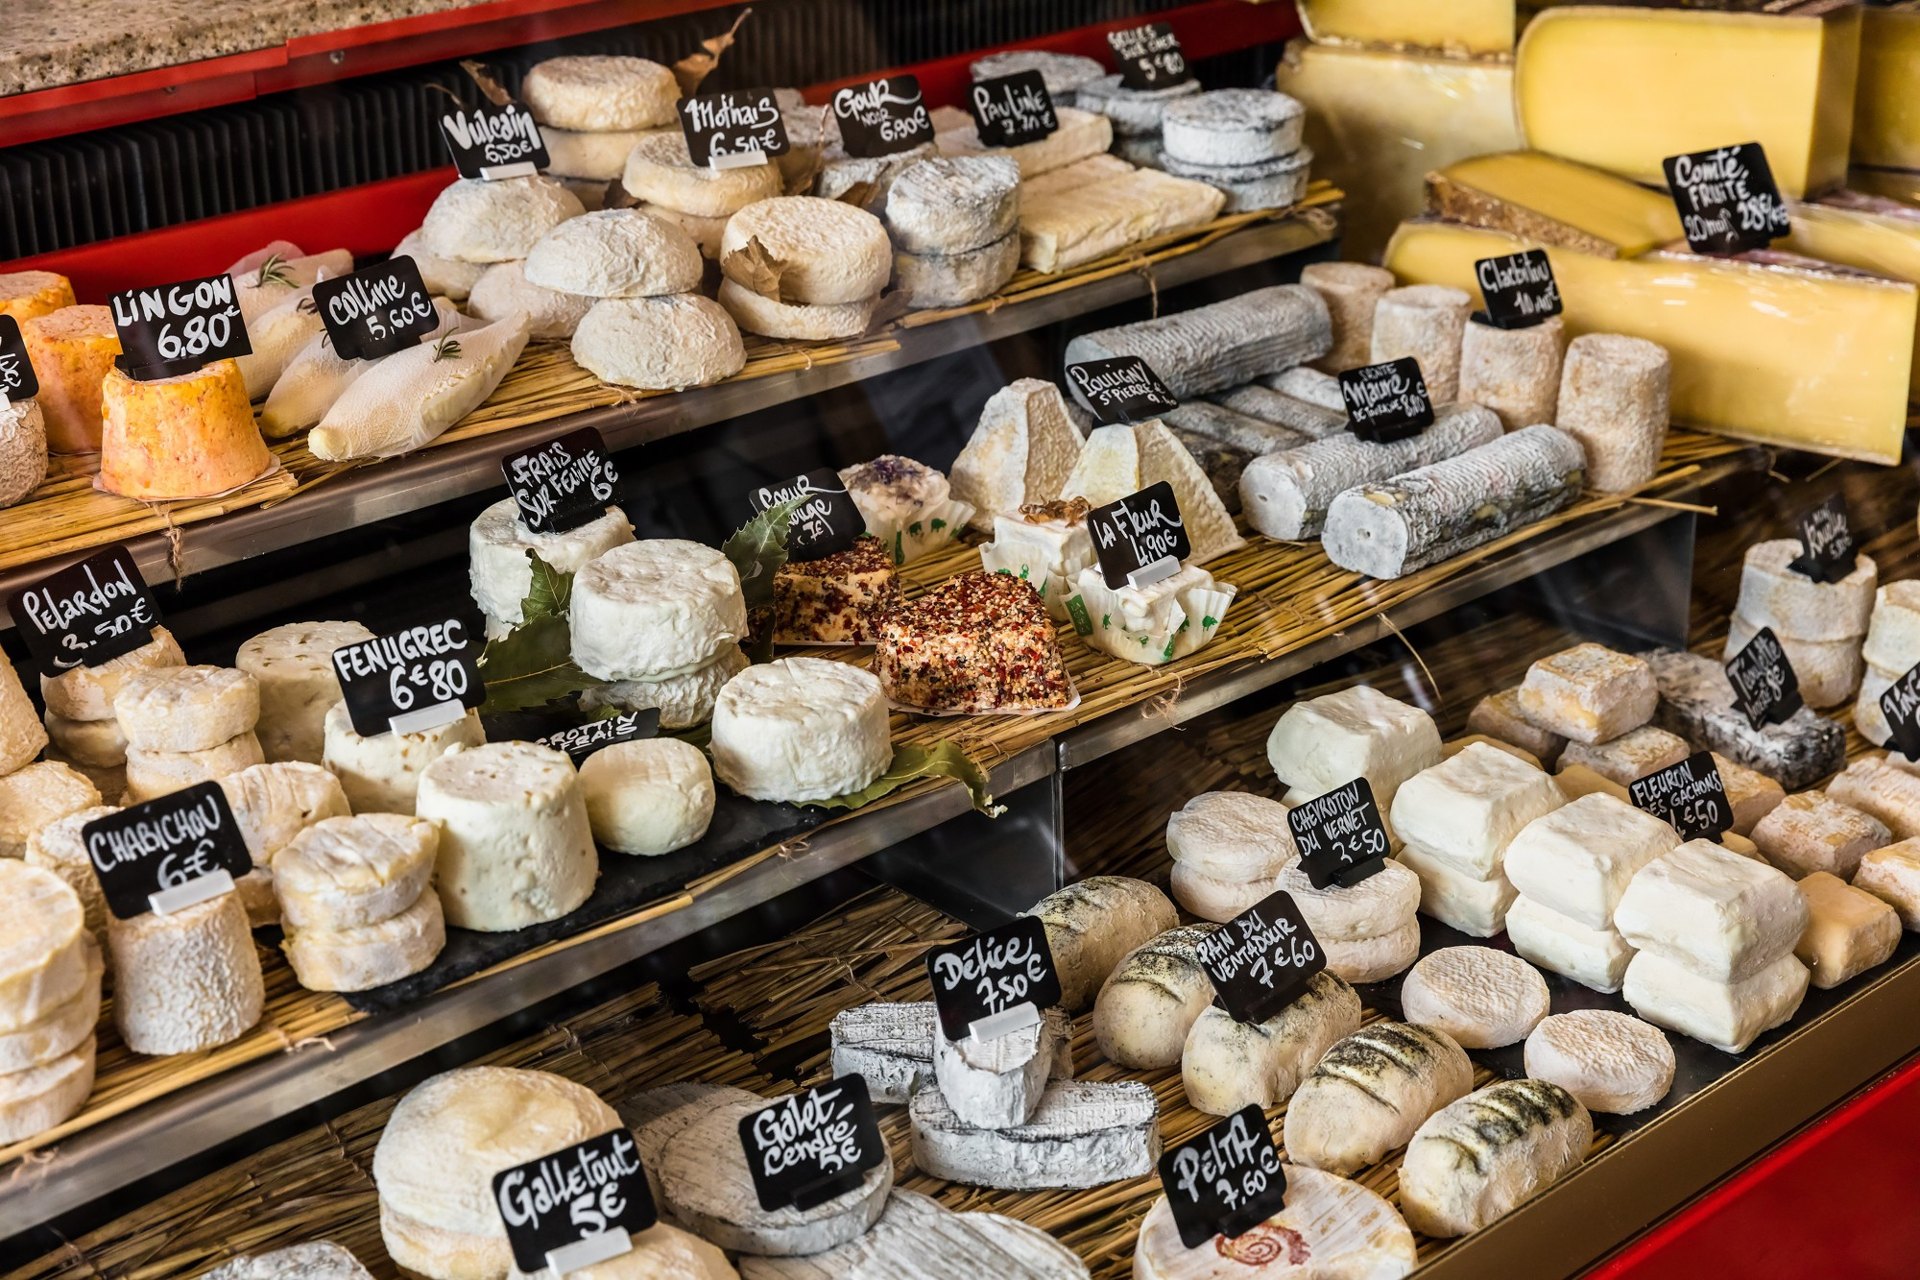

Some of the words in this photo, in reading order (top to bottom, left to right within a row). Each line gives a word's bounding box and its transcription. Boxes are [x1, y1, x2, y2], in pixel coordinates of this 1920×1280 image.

[443, 104, 541, 150] Vulcain
[1677, 146, 1744, 187] Comté
[516, 484, 556, 527] SUR
[590, 461, 618, 501] 6€
[790, 499, 834, 535] ouge
[333, 619, 467, 681] FENUGREC
[1291, 782, 1359, 833] CHEVROTON
[1632, 761, 1694, 806] FLEURON
[1670, 770, 1723, 807] GACHONS
[89, 794, 221, 872] CHABICHOU
[1297, 835, 1322, 856] DU
[1323, 801, 1370, 841] VERNET
[157, 839, 219, 890] 6€
[1211, 917, 1298, 982] VENTADOUR
[1238, 909, 1267, 940] DU
[934, 937, 1031, 990] Délice
[753, 1088, 842, 1150] Galet
[819, 1137, 862, 1170] 5€
[499, 1133, 640, 1230] Galletout
[570, 1181, 626, 1239] 5€
